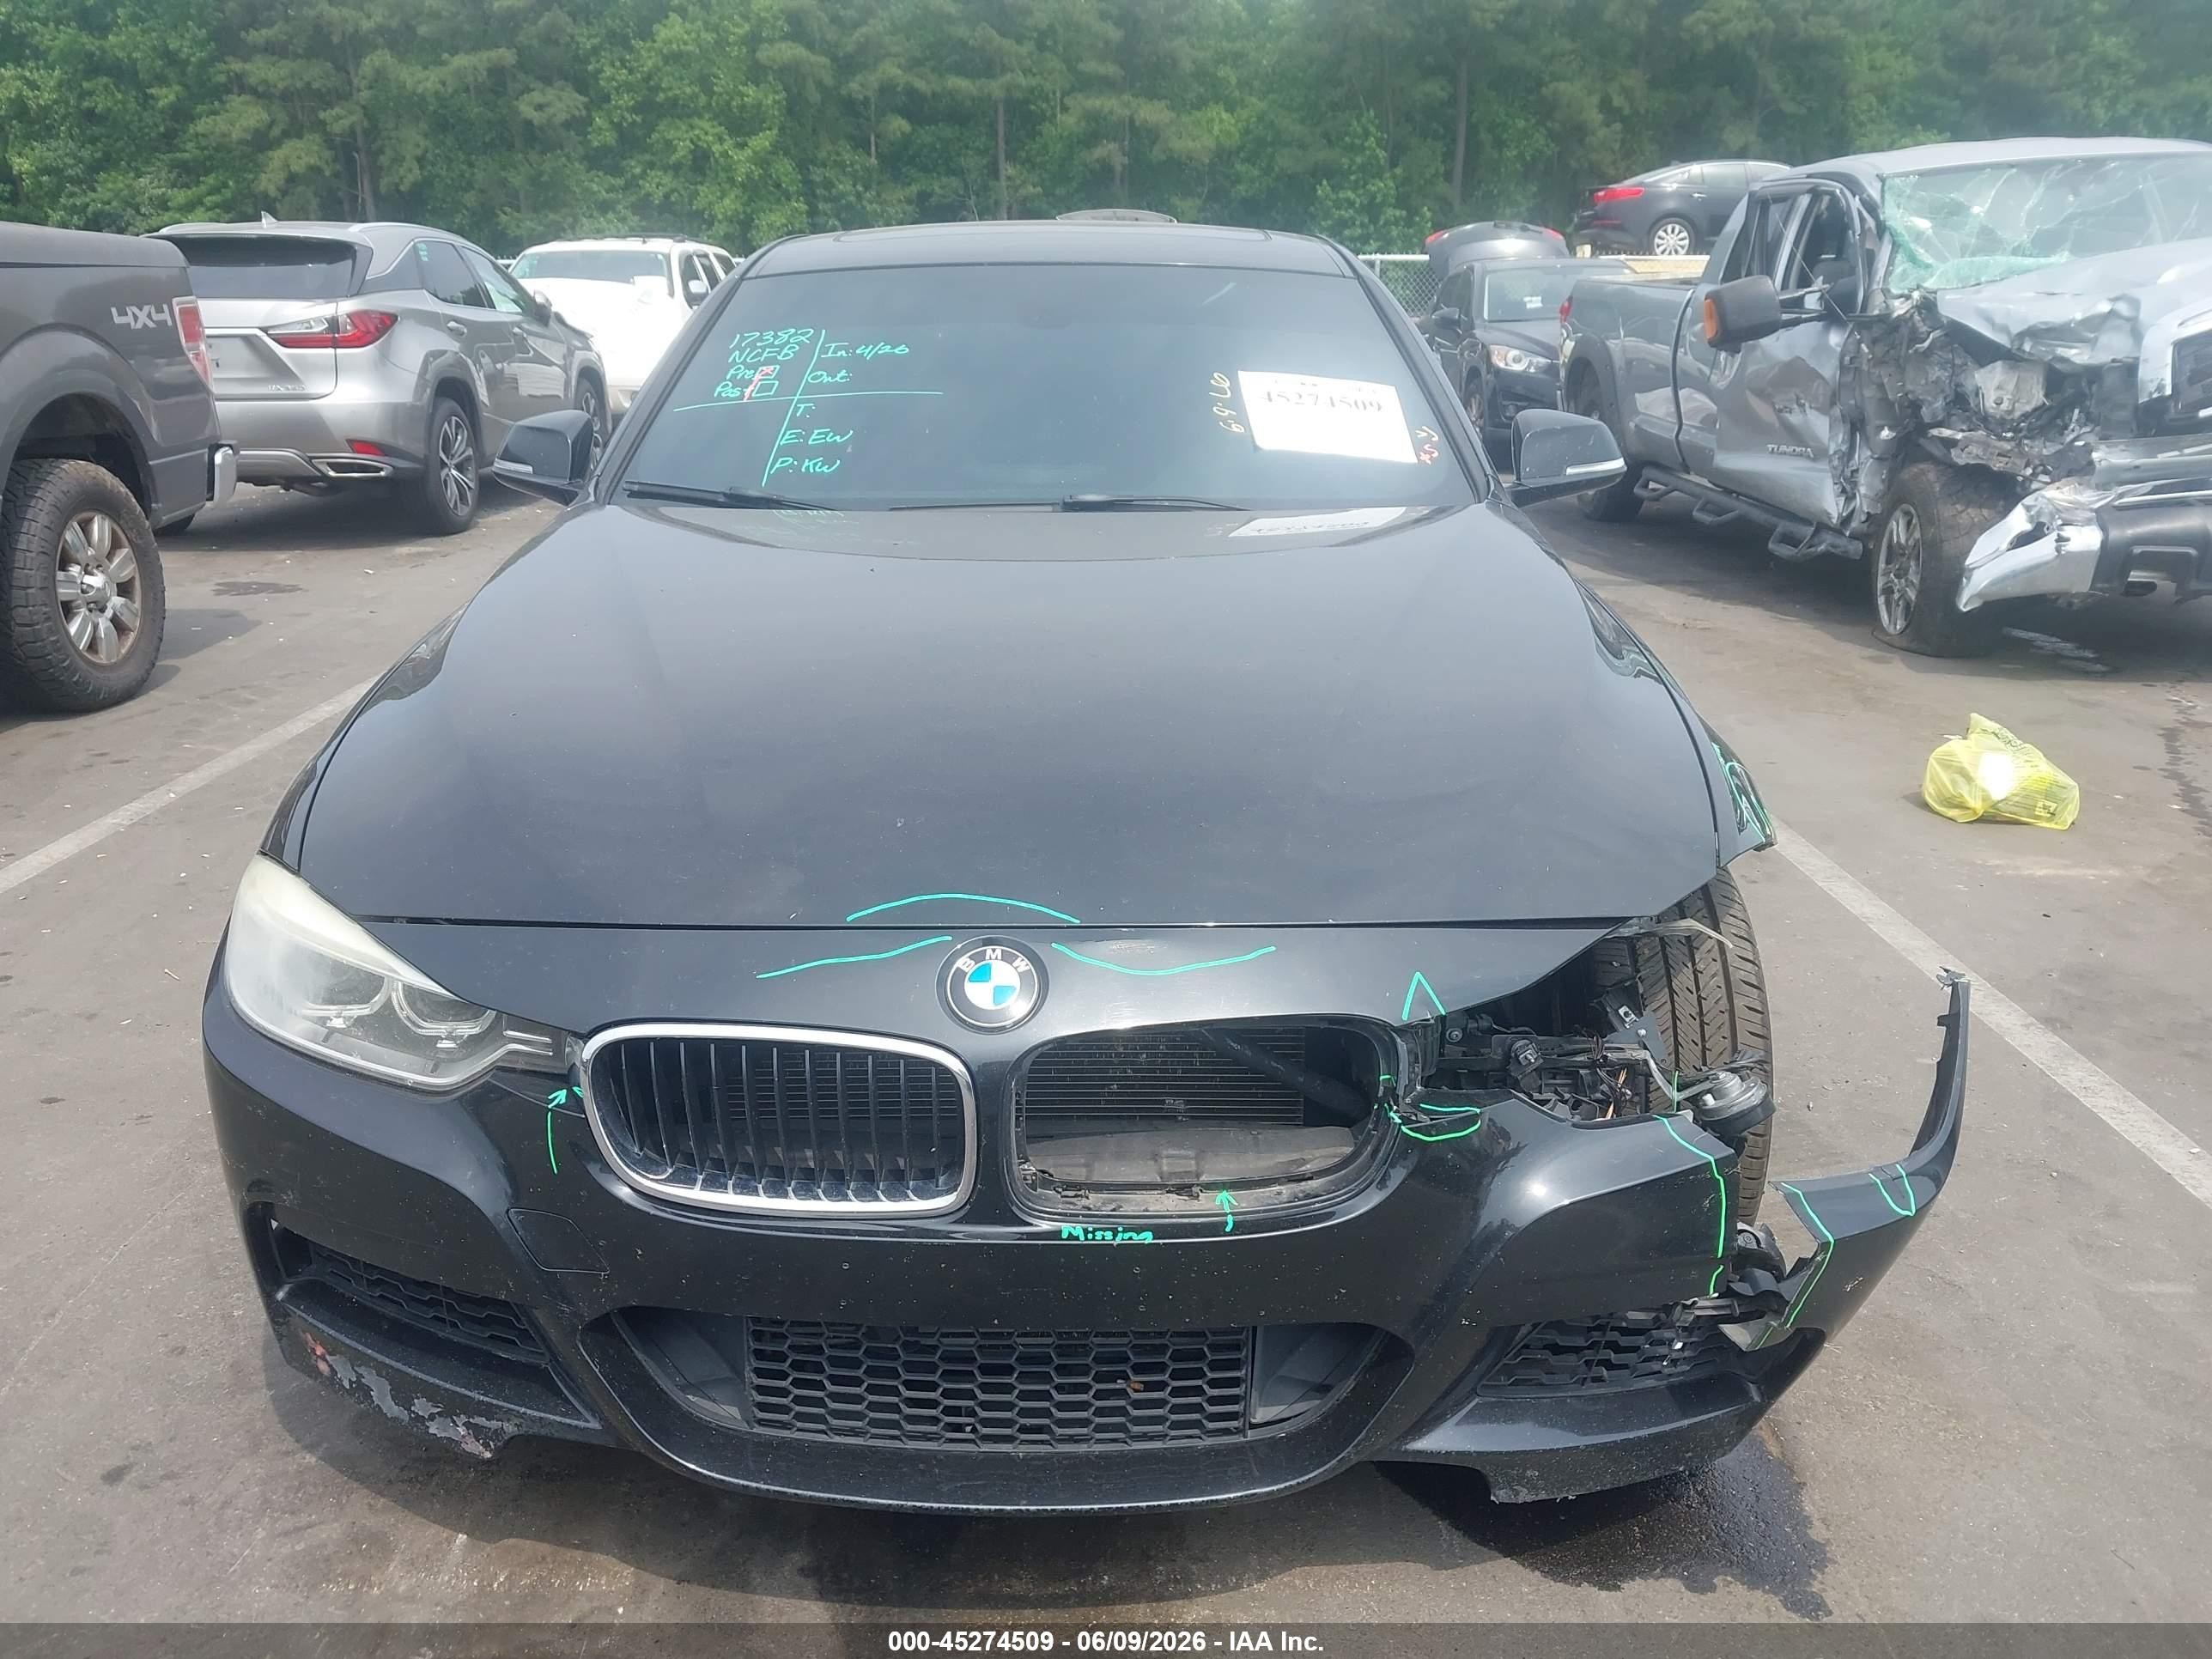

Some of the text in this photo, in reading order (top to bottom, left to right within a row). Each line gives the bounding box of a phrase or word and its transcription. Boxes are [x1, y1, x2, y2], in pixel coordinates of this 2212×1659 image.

[729, 329, 814, 349] 17382
[728, 343, 800, 363] NCFB
[821, 342, 853, 357] In:
[1766, 443, 1814, 459] TUNDRA
[957, 948, 1030, 973] BMW
[1061, 1225, 1153, 1243] Missing
